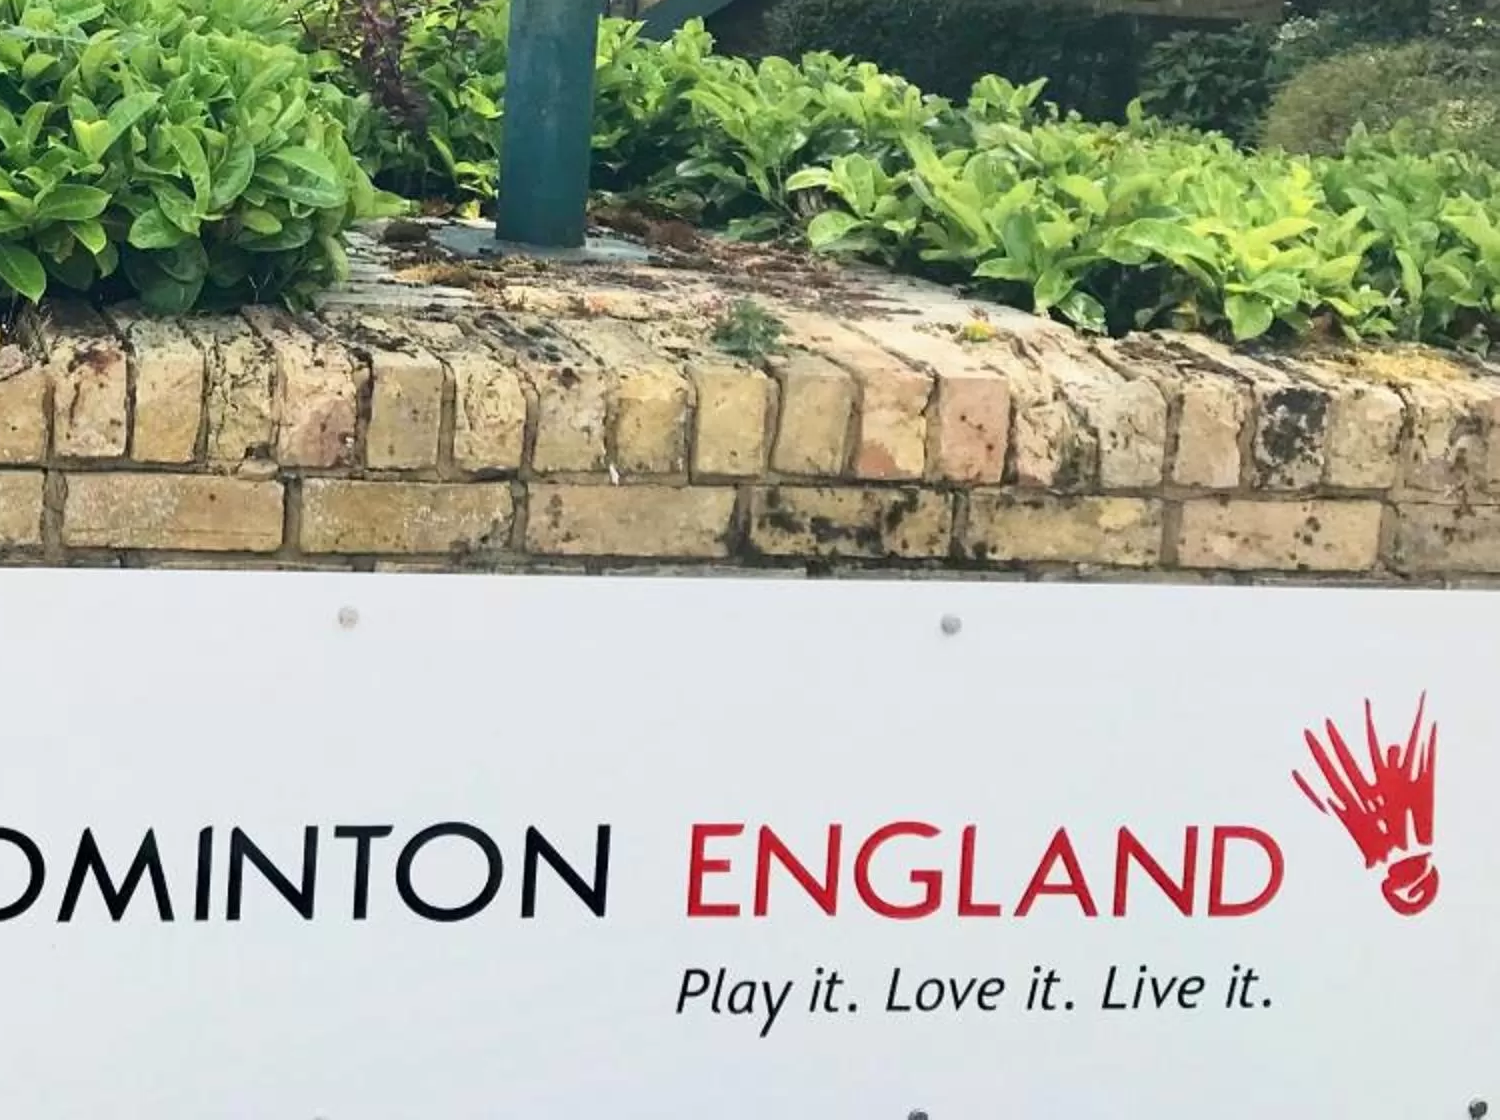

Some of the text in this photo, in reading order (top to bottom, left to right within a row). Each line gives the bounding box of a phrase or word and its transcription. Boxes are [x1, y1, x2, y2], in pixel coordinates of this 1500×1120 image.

[686, 821, 1284, 920] ENGLAND
[675, 963, 1272, 1038] Play it. Love it. Live it.
